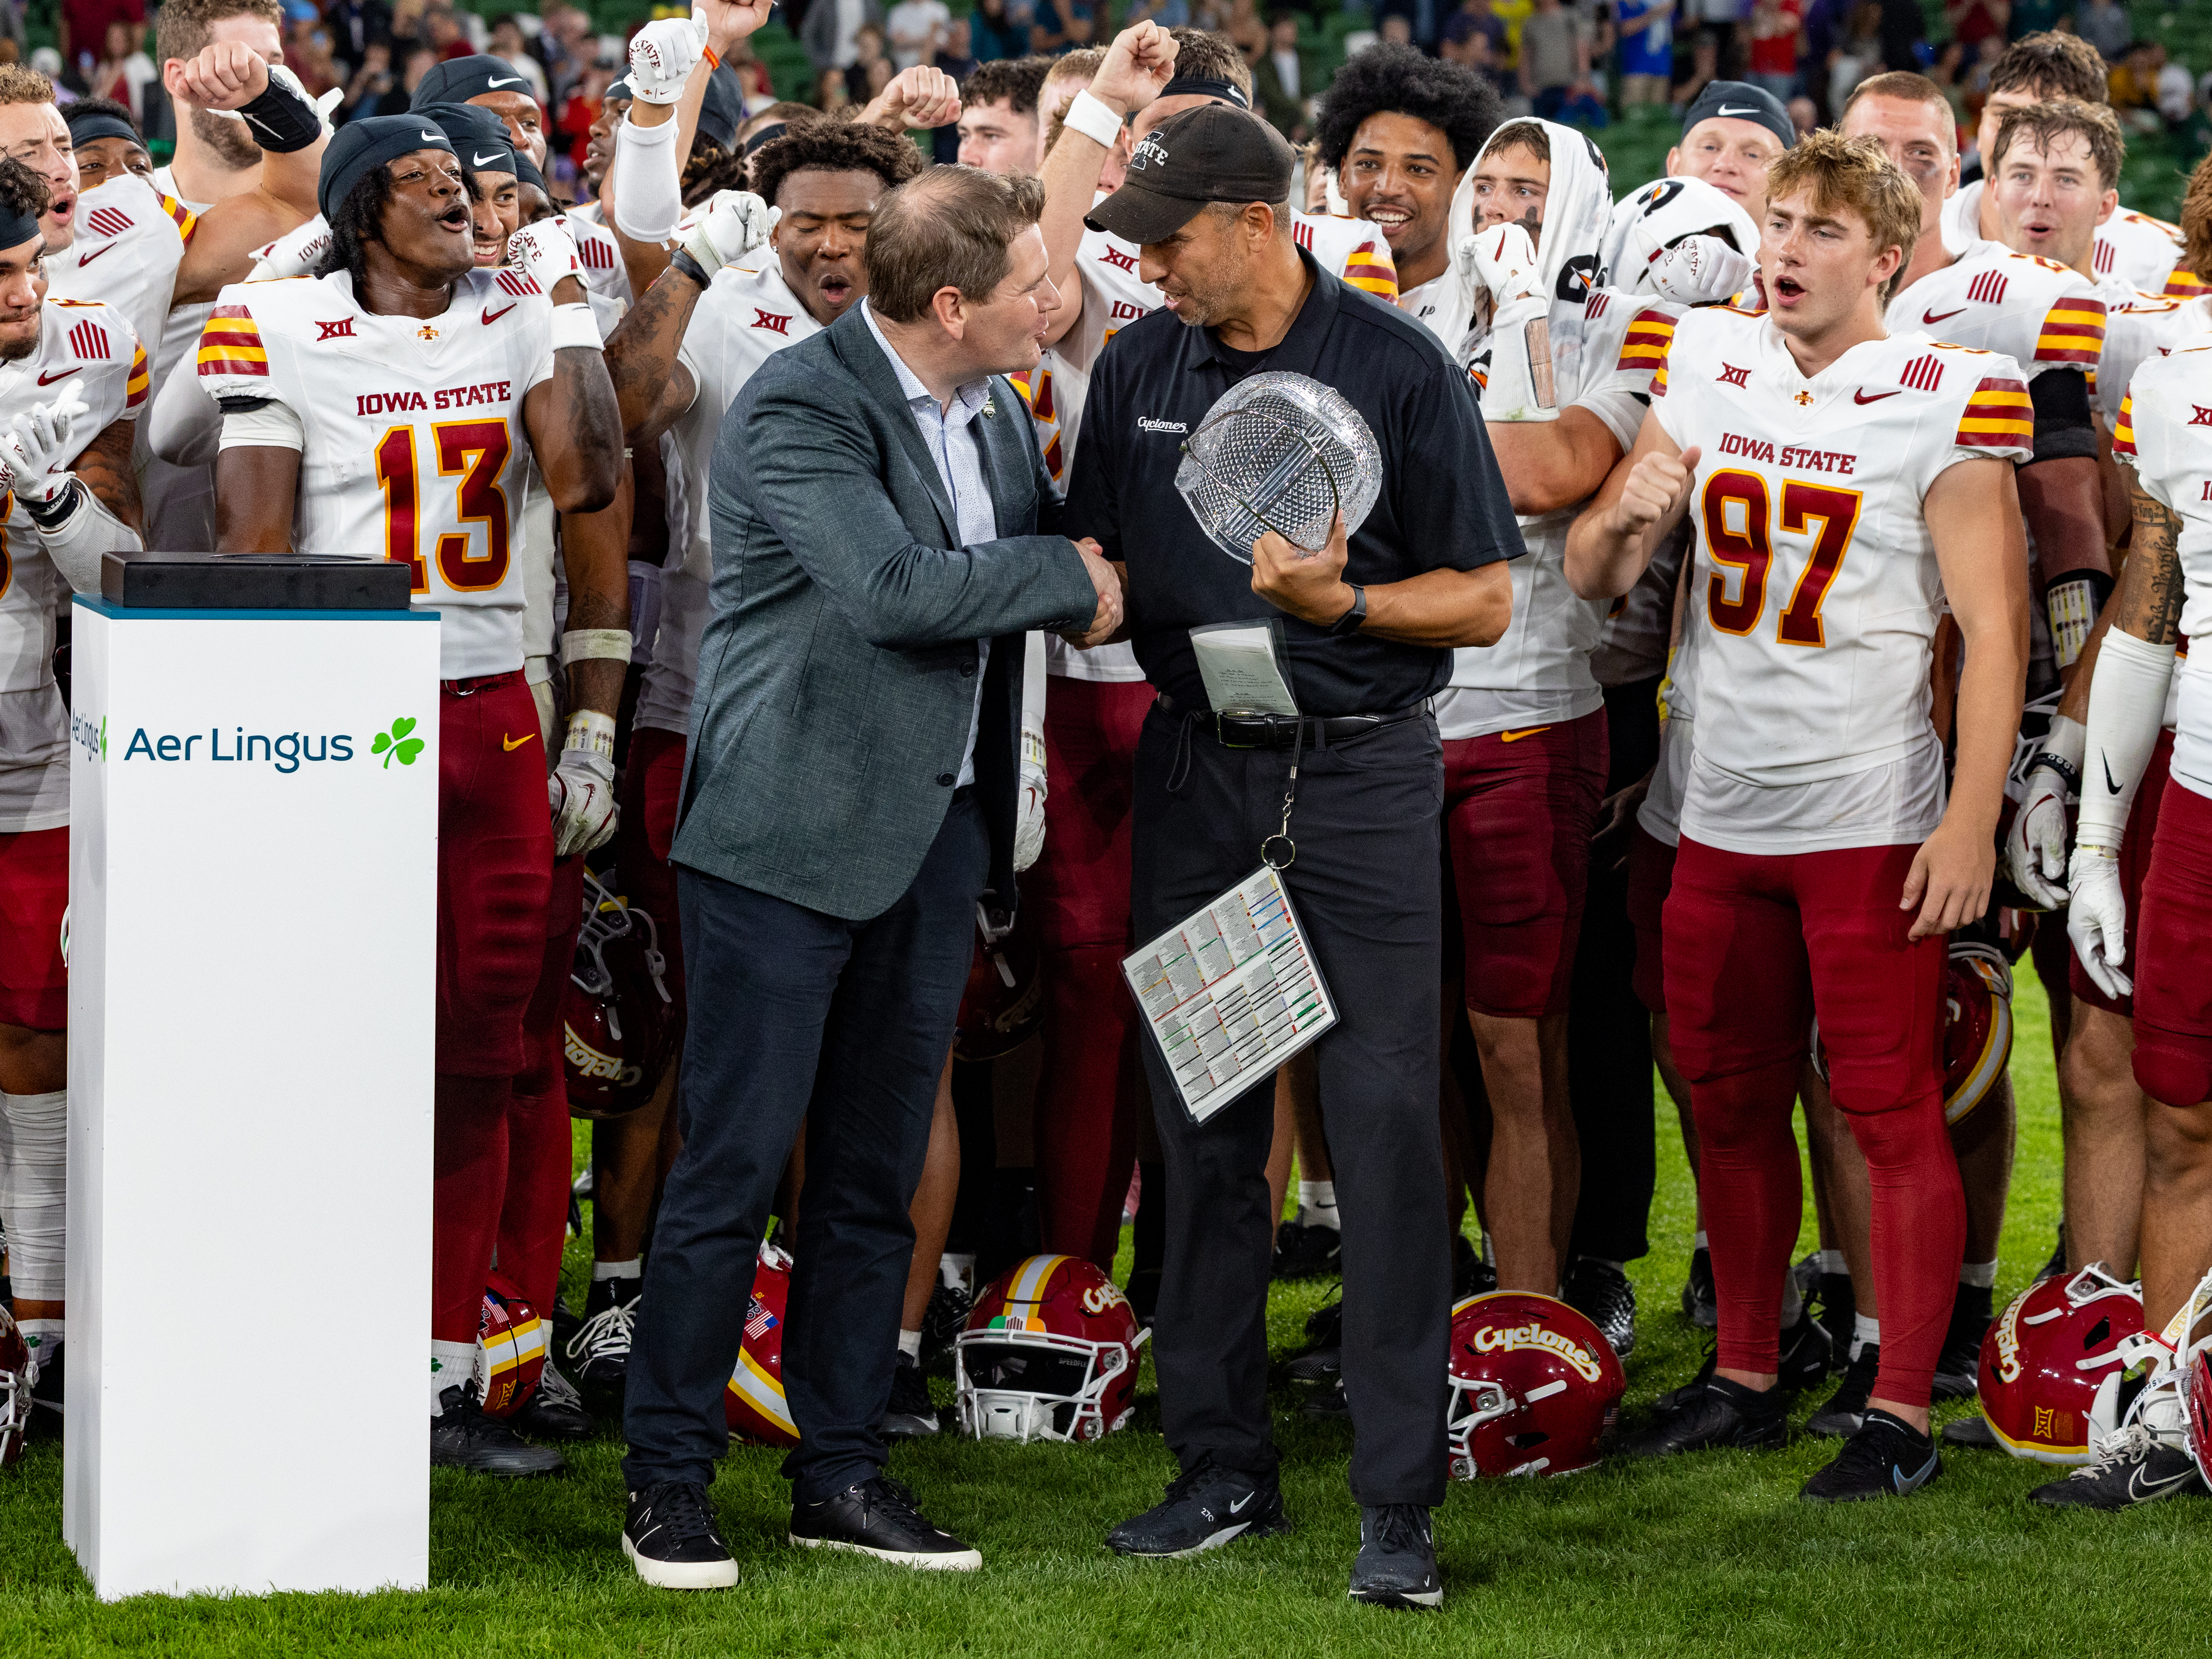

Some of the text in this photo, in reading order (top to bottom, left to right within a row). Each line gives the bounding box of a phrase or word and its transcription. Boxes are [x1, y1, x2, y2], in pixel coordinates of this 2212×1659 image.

[1098, 244, 1140, 275] XII
[750, 308, 792, 336] XII
[1110, 300, 1155, 319] IO
[315, 317, 357, 342] XII
[417, 329, 440, 338] STATE
[1716, 362, 1752, 389] XII
[357, 381, 511, 416] IOWA STATE
[1137, 416, 1187, 433] Cyclones
[1719, 432, 1856, 475] IOWA STATE
[46, 494, 64, 511] FIRST
[374, 417, 512, 596] 13
[1701, 467, 1864, 649] 97
[72, 708, 98, 762] Aer Lingus
[124, 726, 353, 773] Aer Lingus
[564, 1019, 643, 1087] Cyclon
[1059, 1358, 1087, 1368] SPEEDFLE
[1474, 1323, 1602, 1382] Cyclones
[1201, 1508, 1214, 1522] 270
